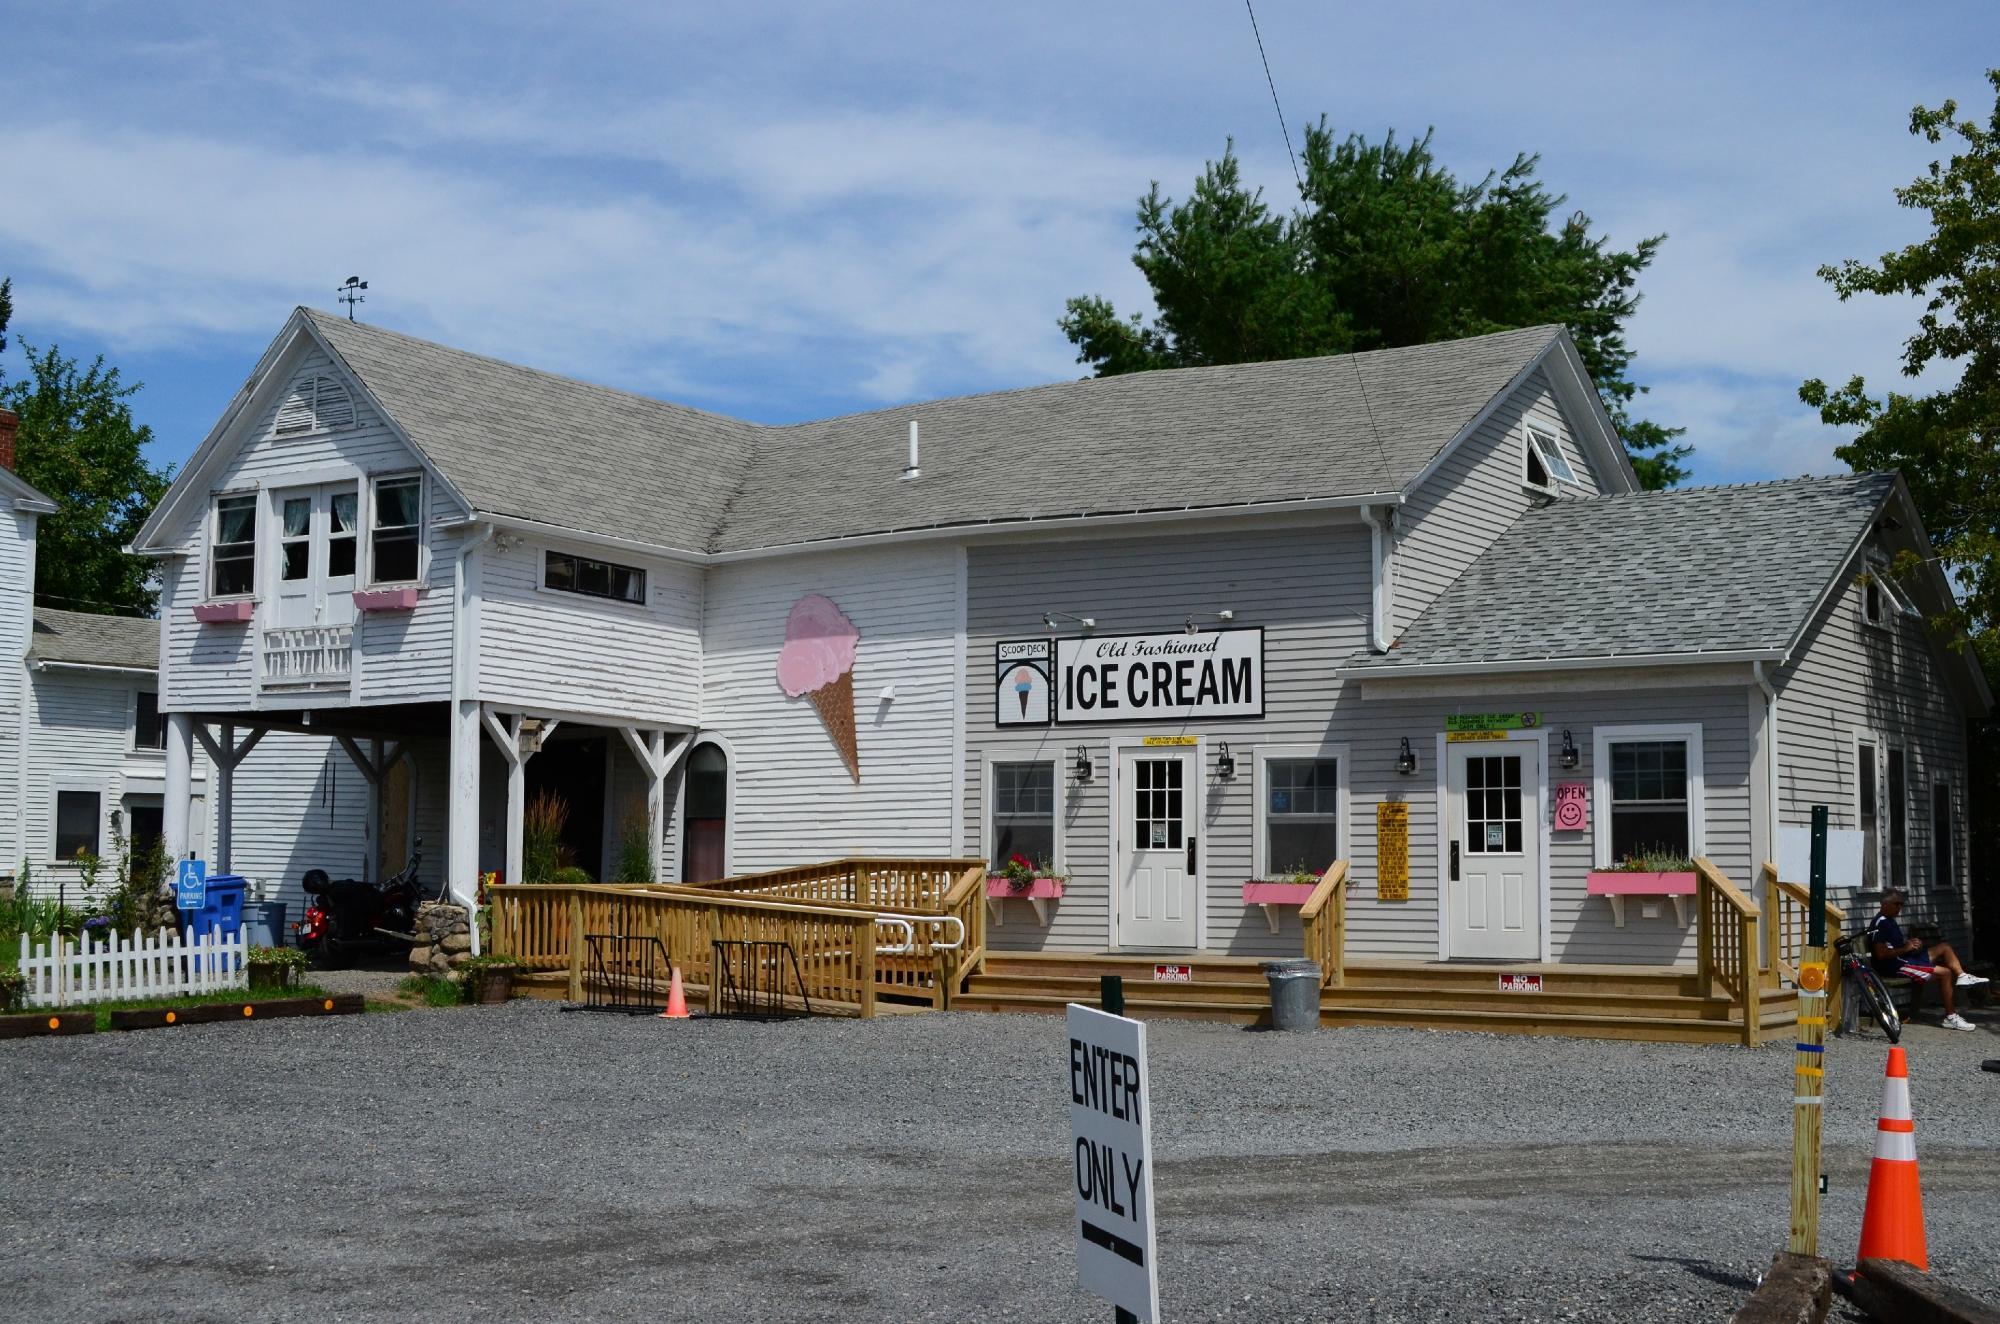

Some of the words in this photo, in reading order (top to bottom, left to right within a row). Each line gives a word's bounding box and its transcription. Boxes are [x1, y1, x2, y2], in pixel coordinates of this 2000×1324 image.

[1001, 645, 1026, 658] SCOOP
[1027, 644, 1047, 656] DECK
[1096, 640, 1127, 658] Old
[1131, 635, 1220, 657] Fashioned
[1066, 663, 1119, 710] ICE
[1127, 657, 1252, 708] CREAM
[1557, 786, 1586, 800] OPEN
[179, 892, 203, 900] PARKING
[1156, 972, 1189, 981] PARKING
[1166, 966, 1179, 974] NO
[1512, 975, 1528, 983] NO
[1502, 982, 1539, 991] PARKING
[1070, 1037, 1141, 1126] ENTER
[1075, 1136, 1143, 1223] ONLY
